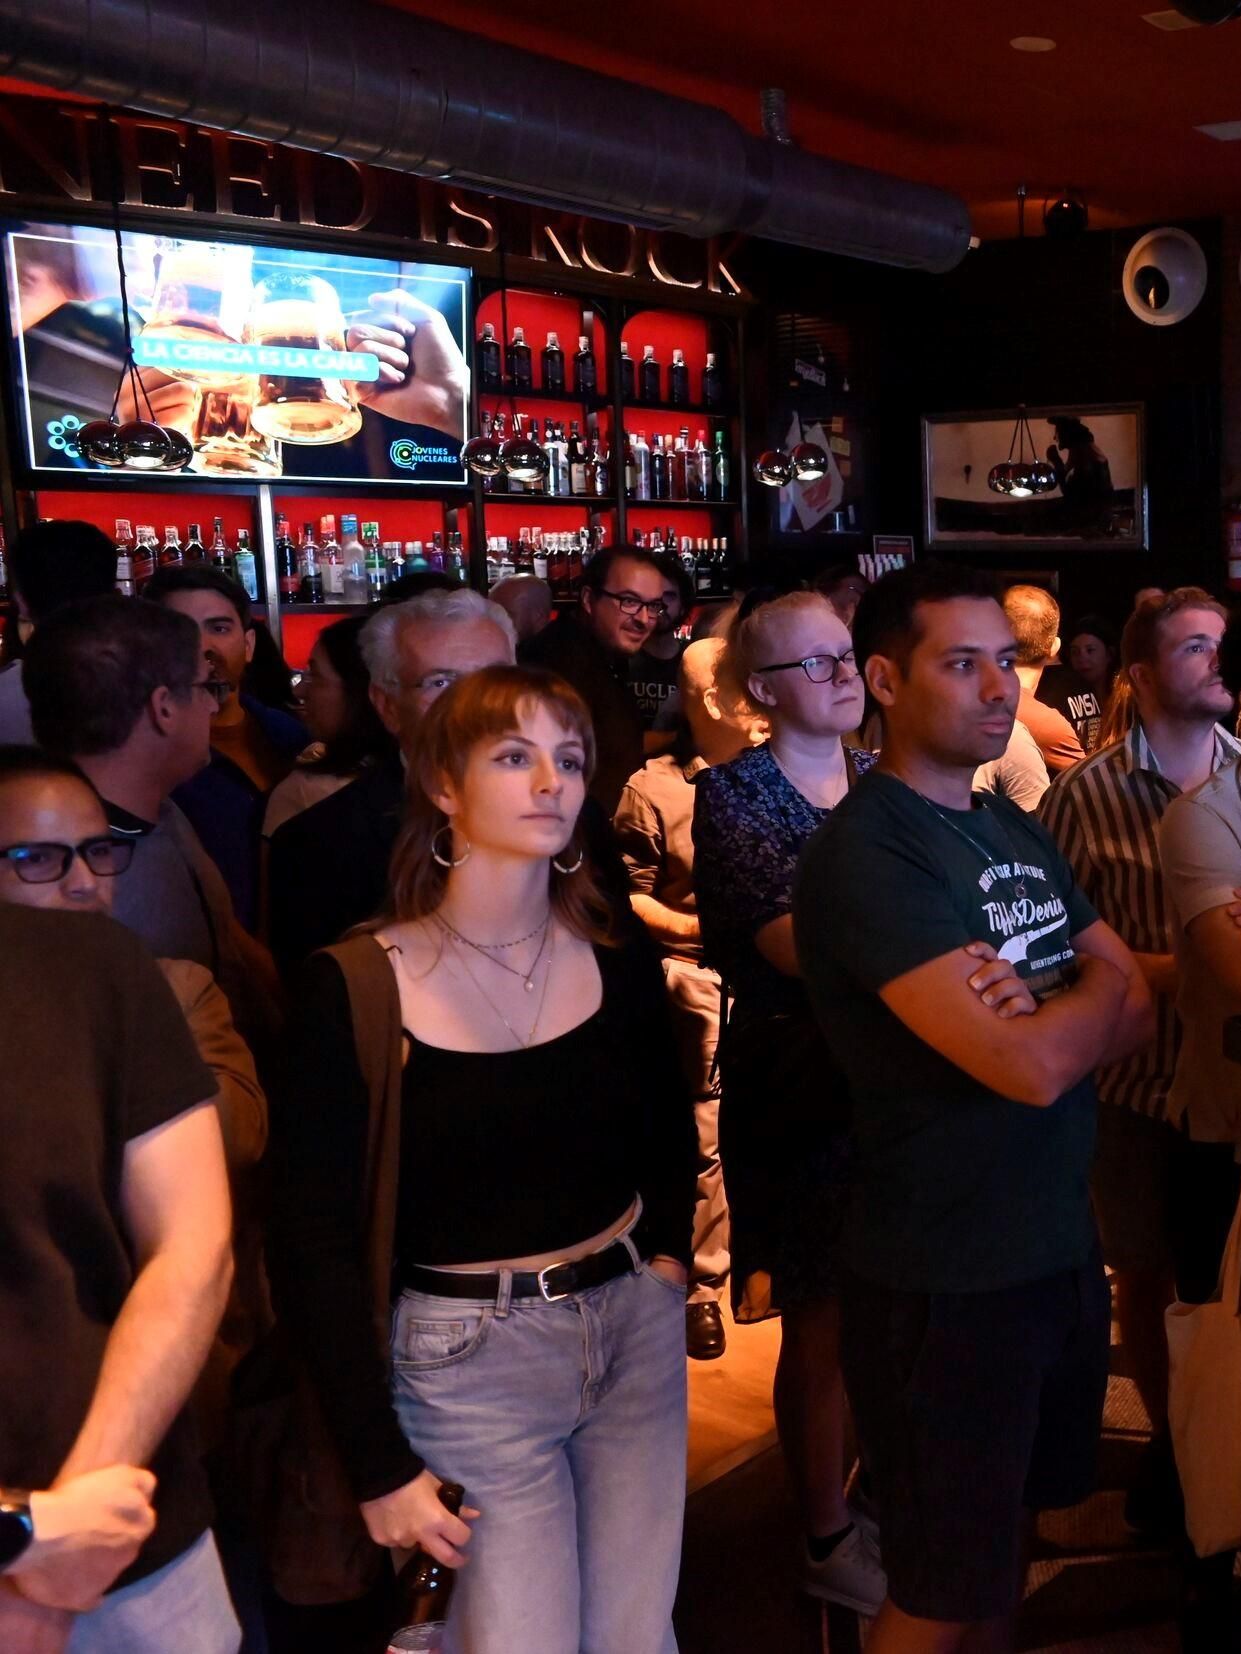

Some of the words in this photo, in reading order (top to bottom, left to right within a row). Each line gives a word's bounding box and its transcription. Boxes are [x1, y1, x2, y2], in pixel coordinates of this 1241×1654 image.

[143, 341, 168, 358] LA
[284, 351, 307, 367] LA
[411, 454, 458, 463] NUCLEARES
[1067, 692, 1101, 720] NASA
